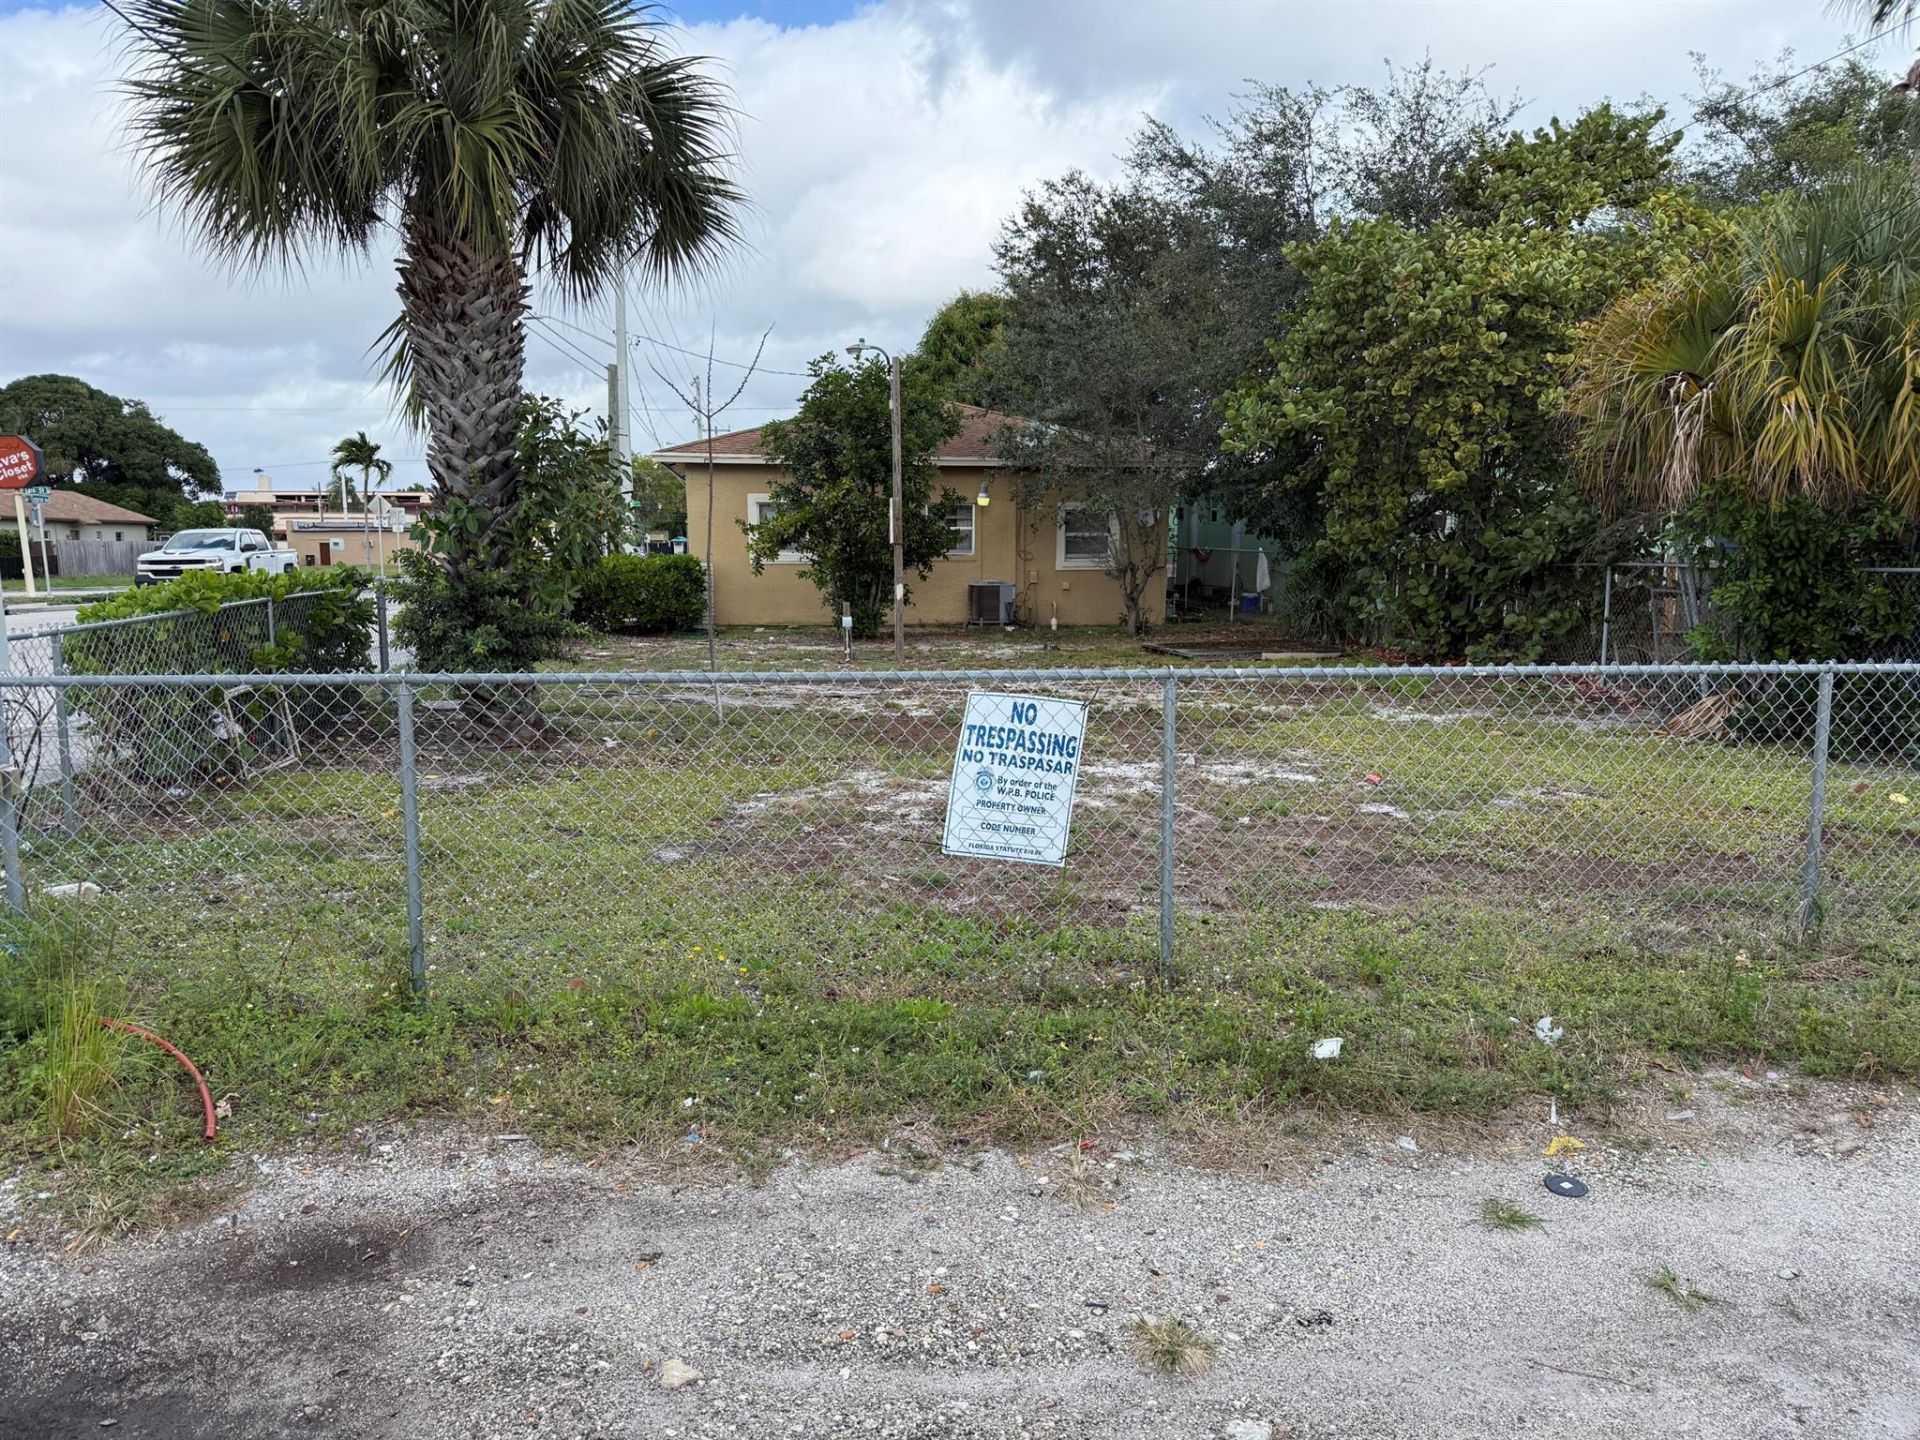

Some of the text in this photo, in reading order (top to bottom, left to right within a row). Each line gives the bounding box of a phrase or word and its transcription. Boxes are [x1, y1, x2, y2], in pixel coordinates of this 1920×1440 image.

[1010, 701, 1038, 726] NO
[966, 724, 1078, 759] TRESPASSING
[961, 749, 1074, 775] NO TRASPASAR
[997, 775, 1057, 791] By order of the
[997, 786, 1055, 801] W.P.B. POLICE
[976, 799, 1046, 815] PROPERTY OWNER
[980, 822, 1036, 836] CODE NUMBER
[968, 842, 994, 851] FLORIDA
[995, 845, 1023, 855] STATUTE
